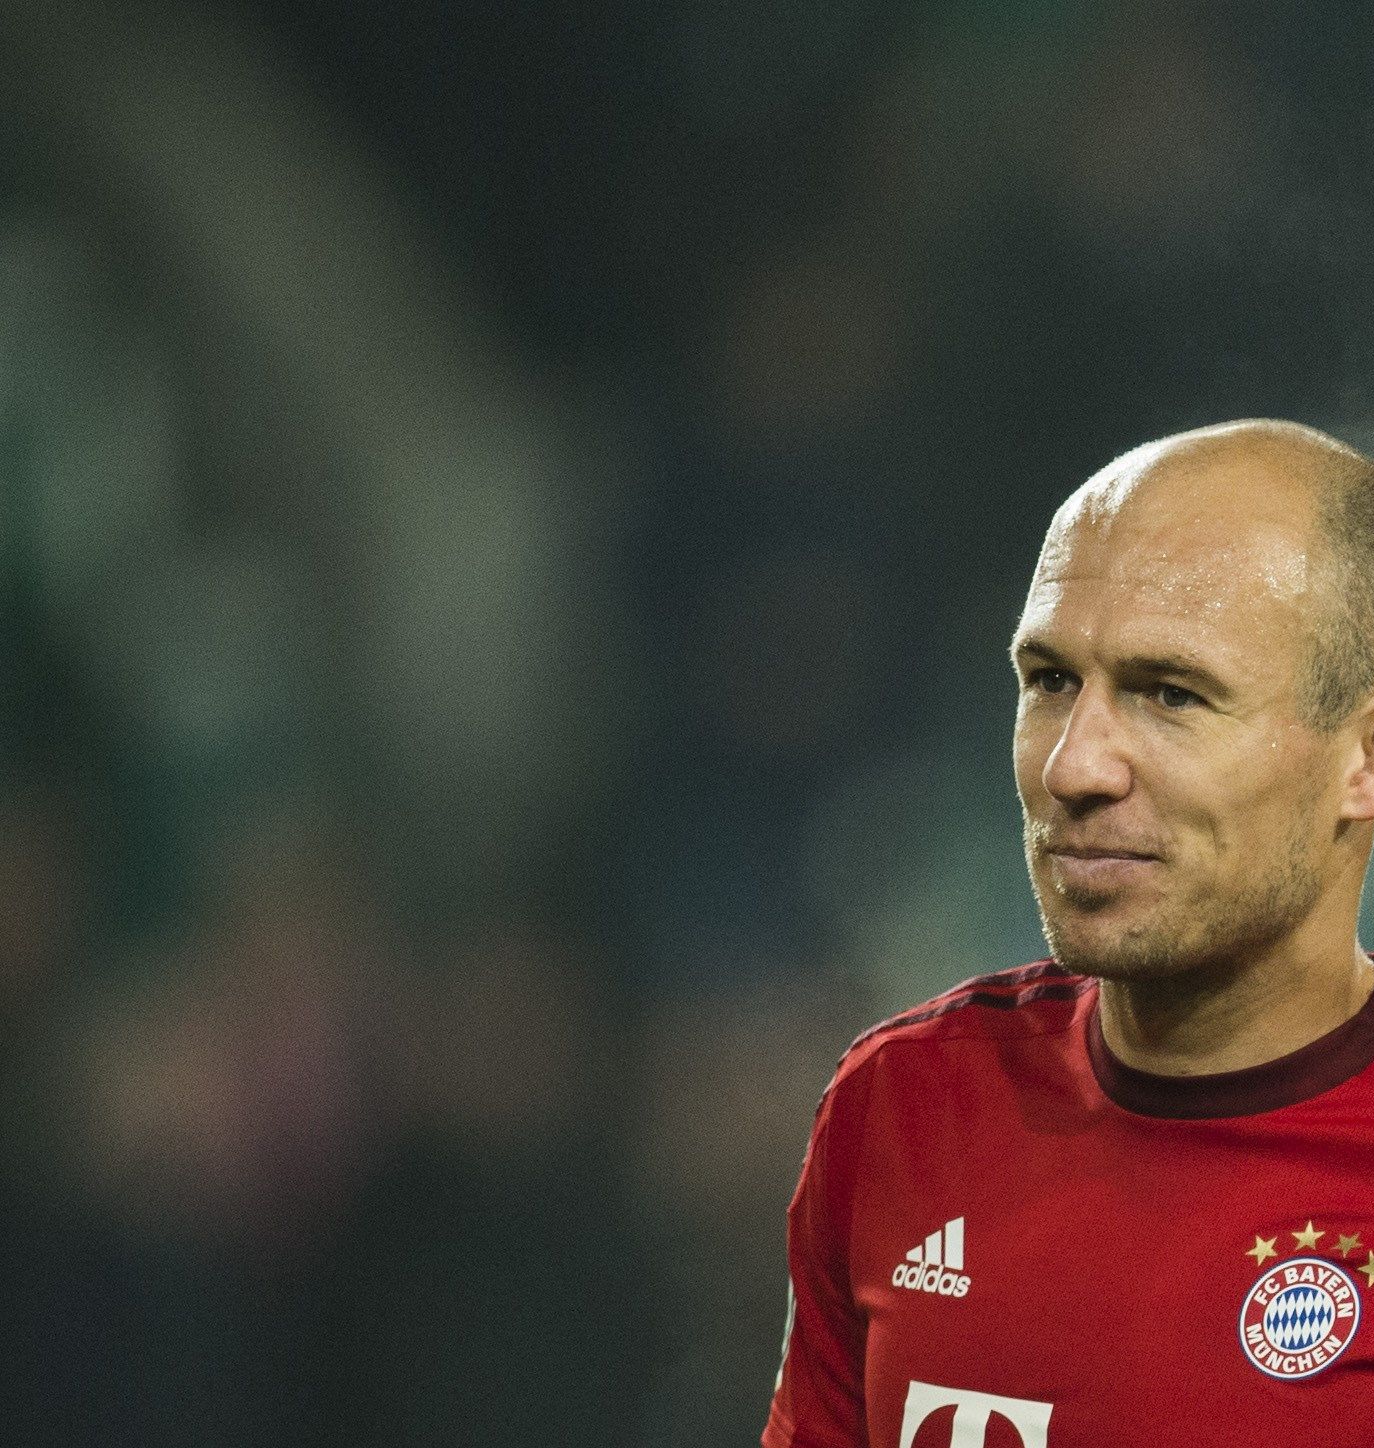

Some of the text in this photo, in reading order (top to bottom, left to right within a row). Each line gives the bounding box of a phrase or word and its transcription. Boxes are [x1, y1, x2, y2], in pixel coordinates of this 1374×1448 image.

[891, 1260, 972, 1298] adidas
[1253, 1265, 1354, 1319] FC BAYERN
